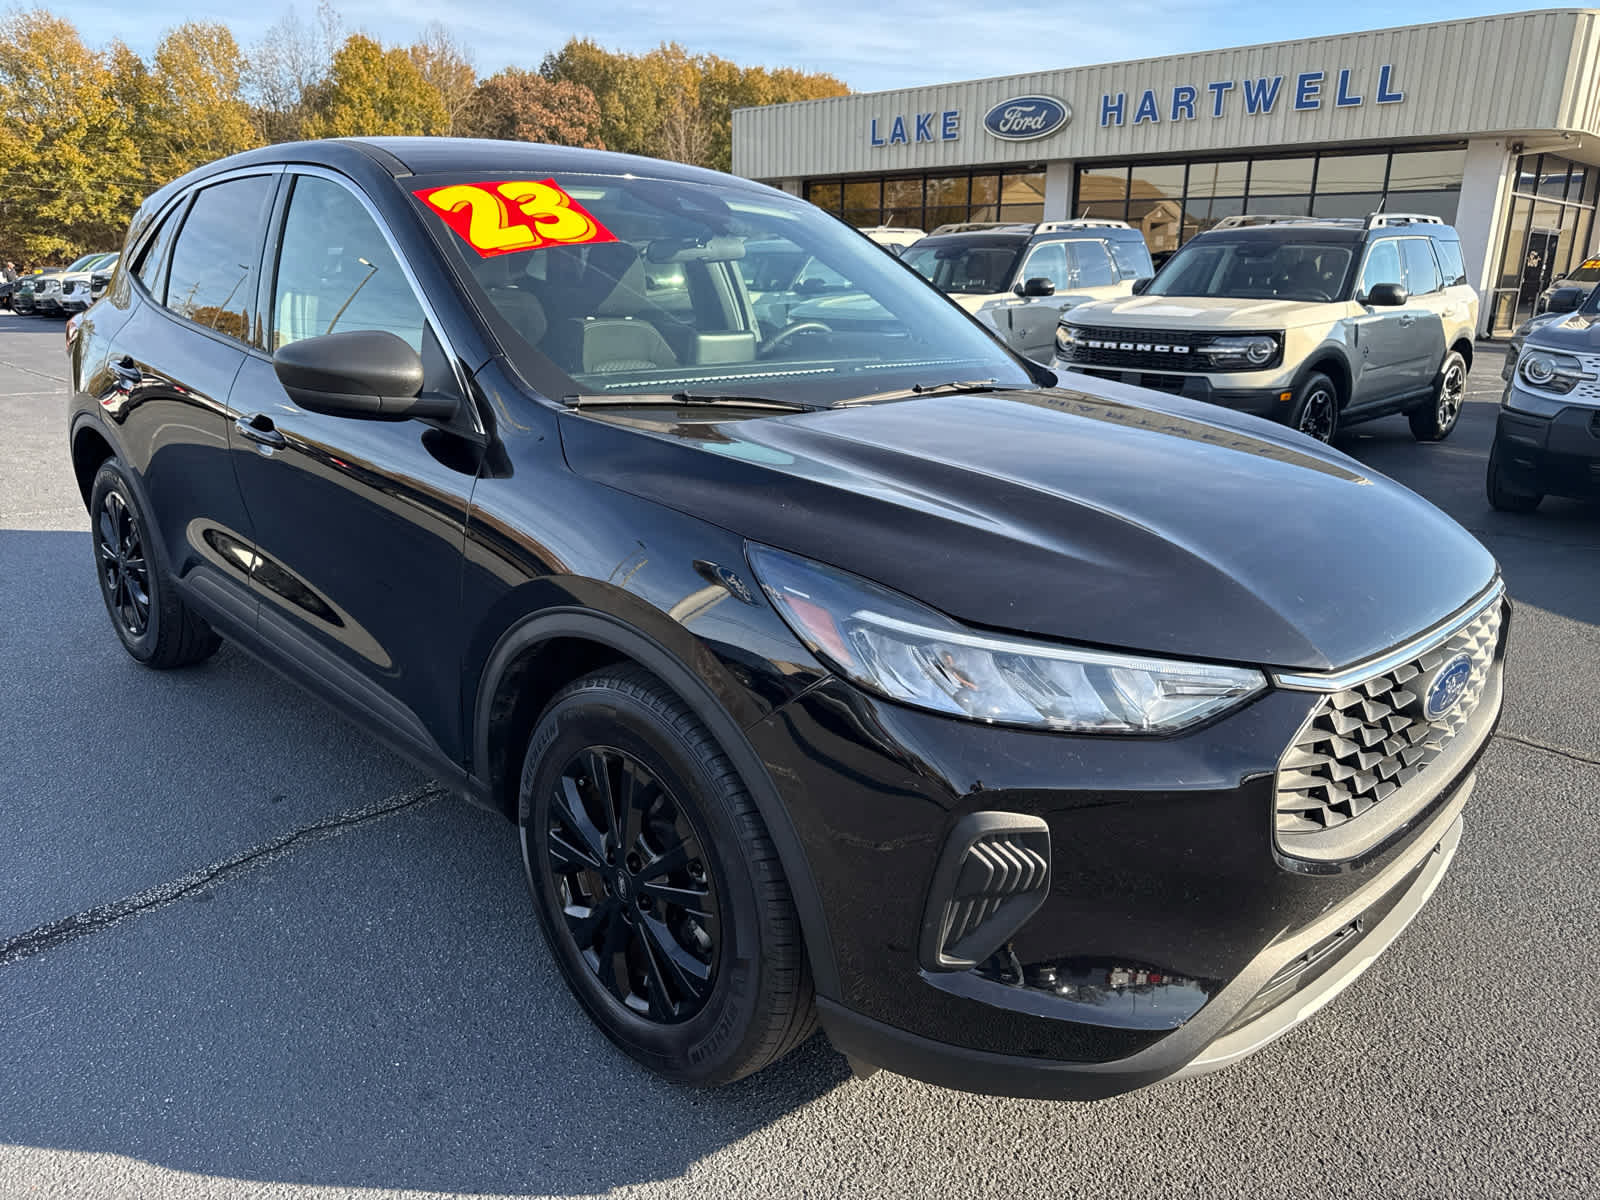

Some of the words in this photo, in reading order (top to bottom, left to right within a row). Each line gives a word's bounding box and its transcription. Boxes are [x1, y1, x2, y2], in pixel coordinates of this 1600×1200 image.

[870, 110, 961, 147] LAKE
[999, 104, 1048, 132] Ford
[1100, 63, 1405, 128] HARTWELL
[428, 181, 598, 251] 23
[1088, 340, 1190, 353] BRONCO
